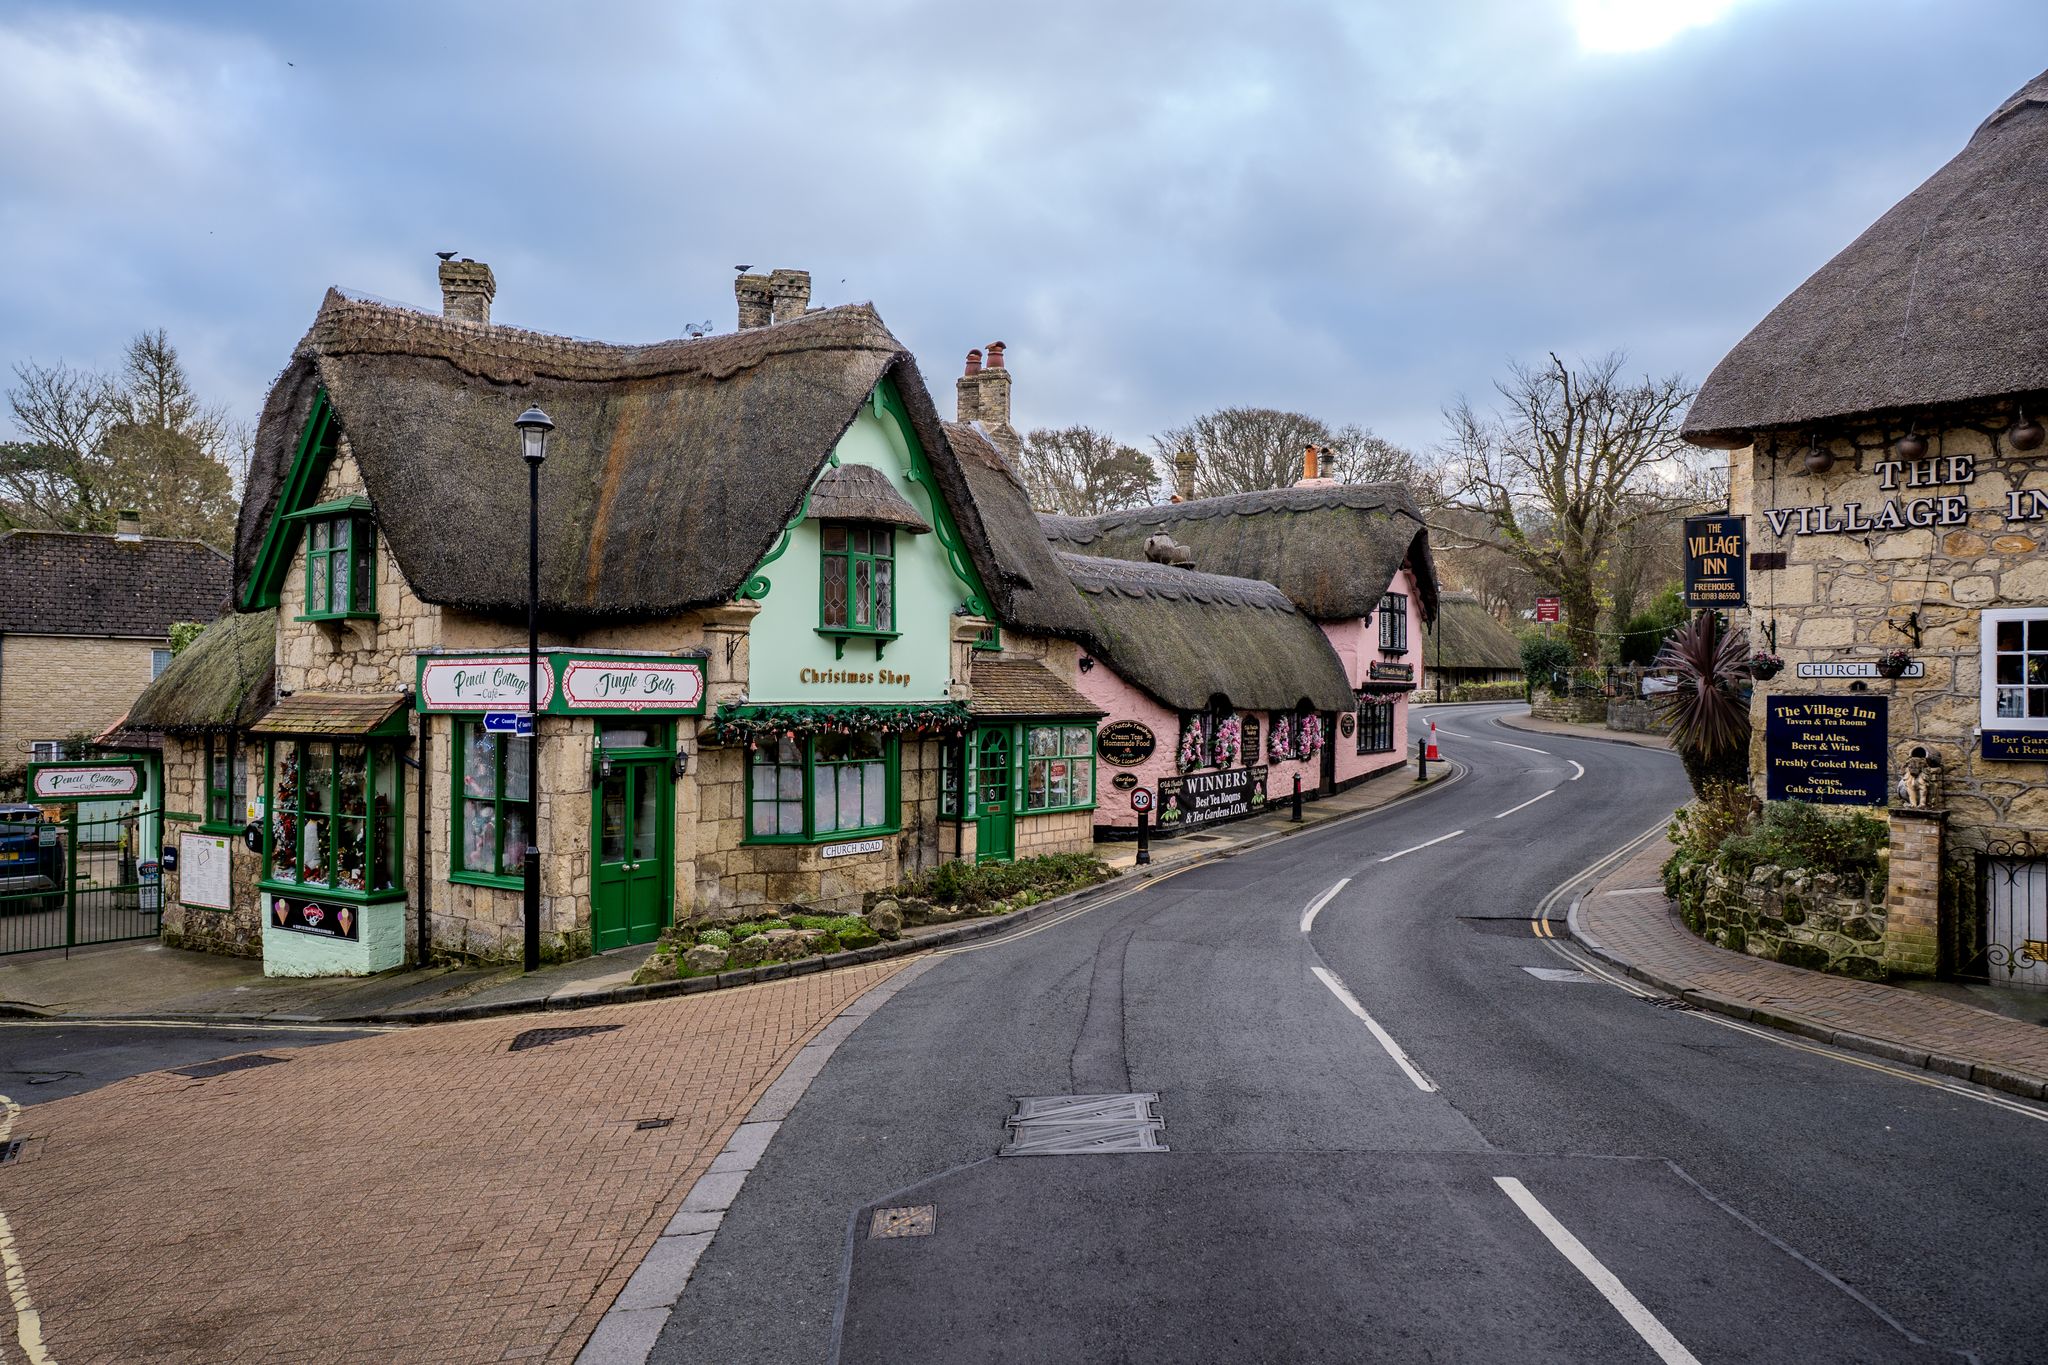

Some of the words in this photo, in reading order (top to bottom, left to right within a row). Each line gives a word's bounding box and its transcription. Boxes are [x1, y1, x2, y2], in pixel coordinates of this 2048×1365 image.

[1875, 455, 1974, 490] THE
[1764, 495, 1968, 536] VILLAGE
[1707, 523, 1722, 533] THE
[1688, 535, 1741, 559] VILLAGE
[1703, 558, 1727, 575] INN
[1694, 583, 1735, 591] FREEHOUSE
[1718, 592, 1740, 600] 865500
[1802, 664, 1868, 676] CHURCH
[454, 670, 487, 697] Pencil
[493, 667, 529, 696] Cottage
[800, 667, 874, 684] Christmas
[879, 669, 911, 687] Shop
[594, 673, 638, 697] Jingle
[644, 674, 676, 695] Bells
[482, 688, 498, 701] Café
[1775, 706, 1800, 718] The
[1803, 704, 1849, 718] Village
[1853, 706, 1876, 719] Inn
[1823, 718, 1837, 726] Tea
[1803, 733, 1824, 741] Real
[1825, 733, 1849, 743] Ales,
[1992, 735, 2019, 744] Beer
[1792, 742, 1817, 751] Beers
[1819, 743, 1828, 751] &
[1831, 743, 1860, 752] Wines
[2006, 745, 2019, 754] At
[1775, 758, 1808, 769] Freshly
[1811, 759, 1846, 768] Cooked
[1849, 760, 1878, 770] Meals
[50, 774, 84, 789] Pencil
[90, 773, 124, 787] Cottage
[1187, 770, 1248, 794] WINNERS
[1808, 776, 1843, 786] Scones,
[1785, 785, 1814, 793] Cakes
[1815, 785, 1825, 794] &
[1826, 786, 1867, 796] Desserts
[1134, 794, 1148, 804] 20
[1195, 795, 1209, 808] Best
[1209, 793, 1221, 806] Tea
[1221, 791, 1241, 804] Rooms
[1186, 812, 1192, 824] &
[1193, 810, 1204, 822] Tea
[1204, 806, 1230, 820] Gardens
[826, 844, 857, 856] CHURCH
[860, 841, 881, 852] ROAD
